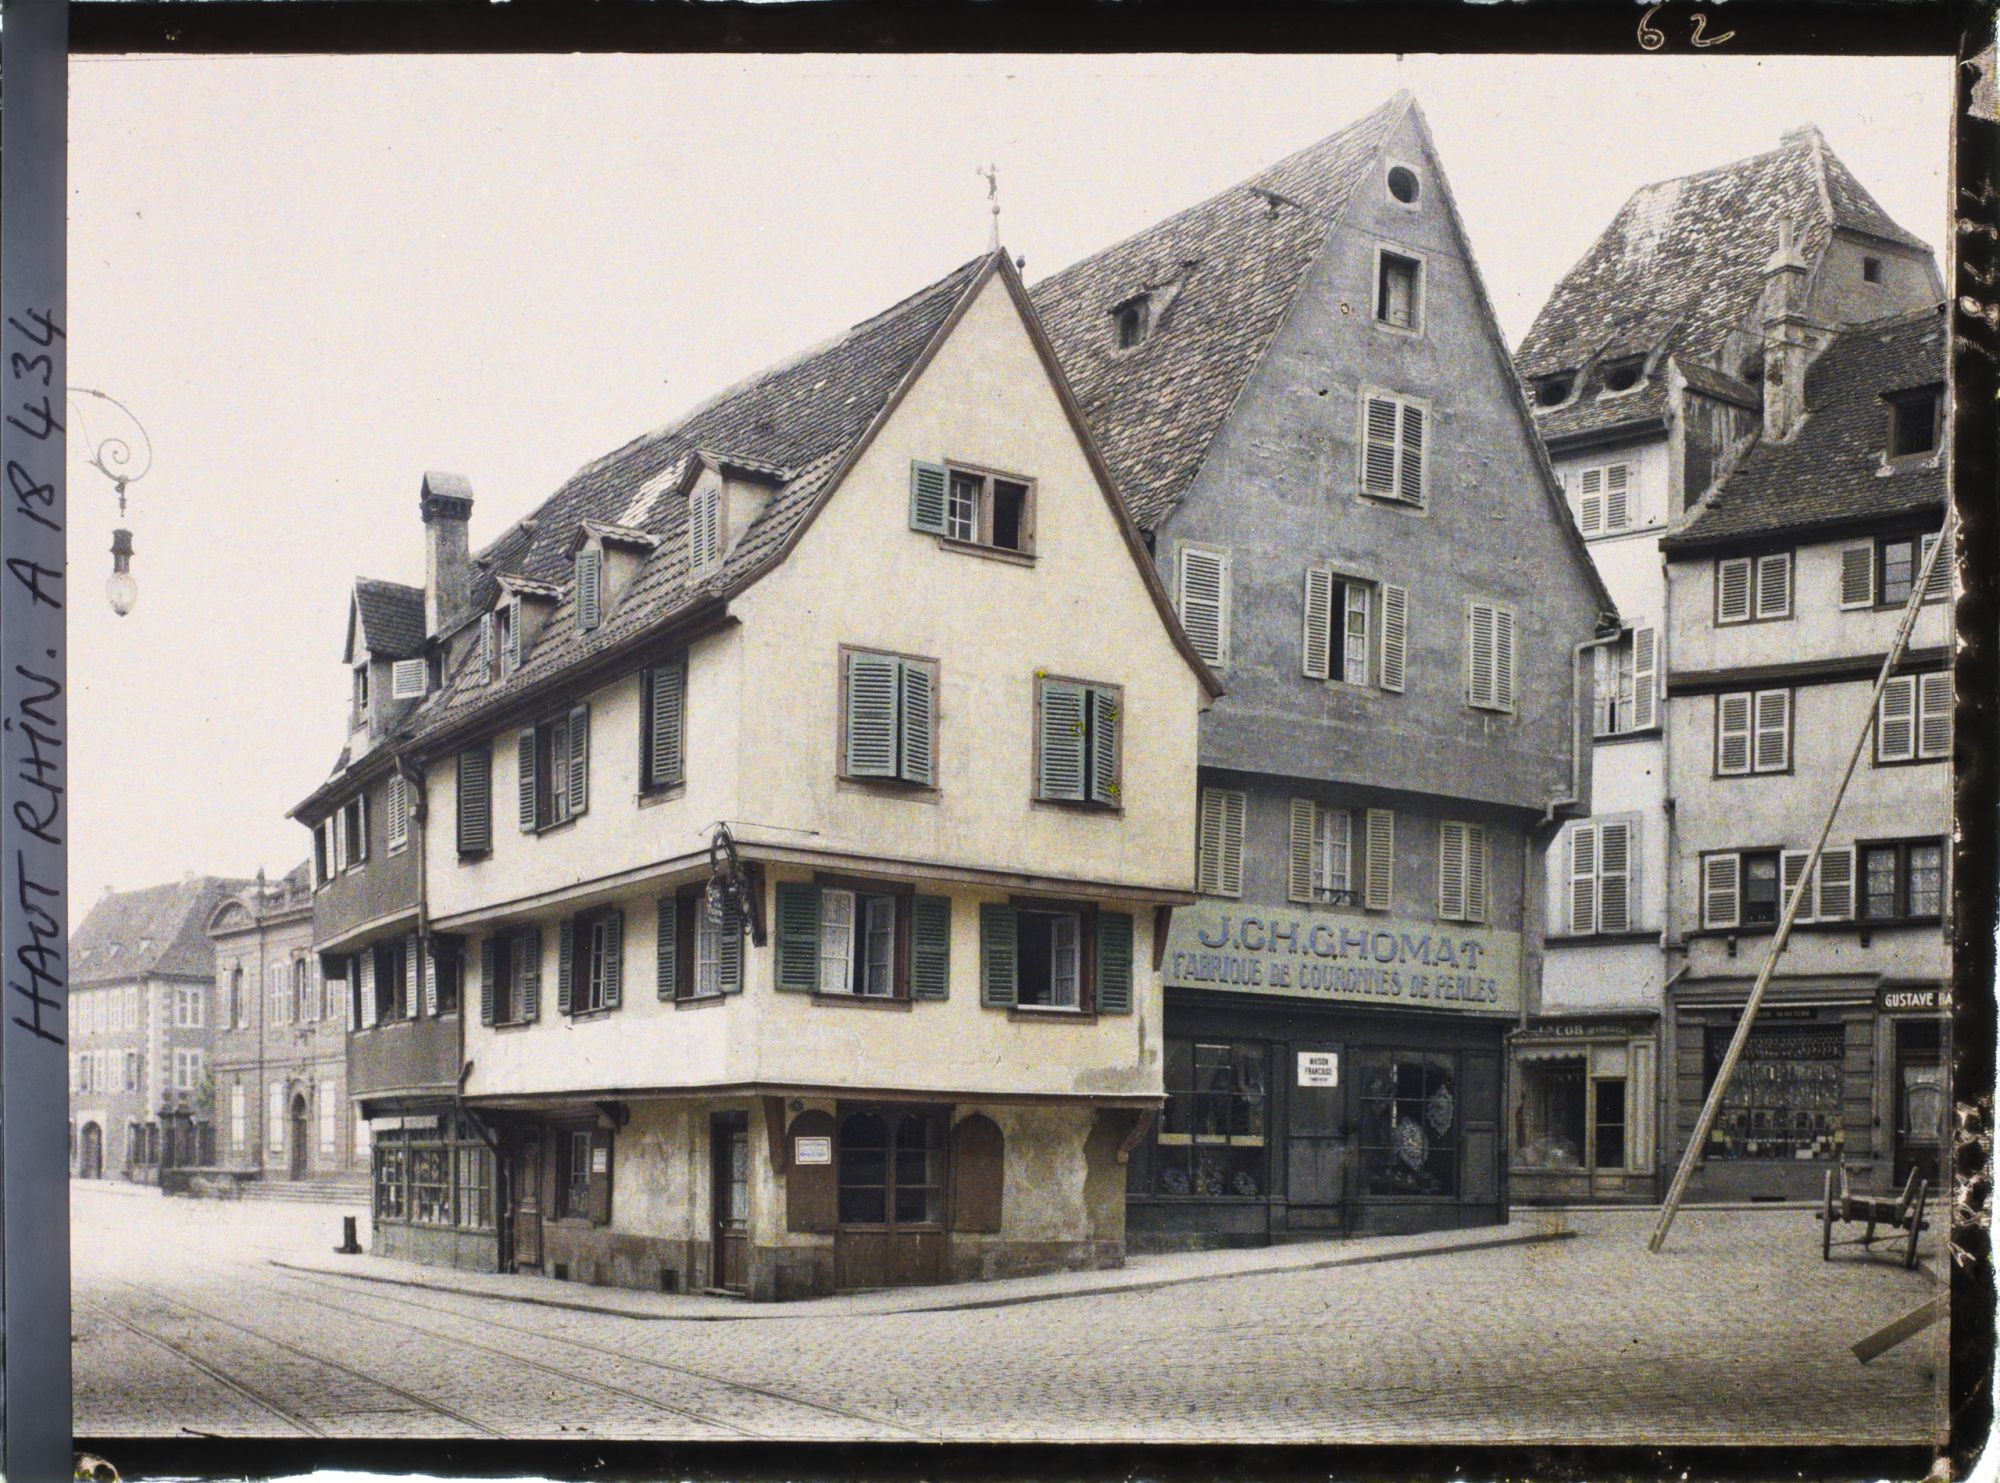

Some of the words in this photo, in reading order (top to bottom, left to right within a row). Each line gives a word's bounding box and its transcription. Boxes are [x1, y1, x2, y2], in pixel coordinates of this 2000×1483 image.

[7, 557, 62, 609] A
[13, 849, 65, 1046] HAUT
[1171, 950, 1262, 987] FABRIQUE
[1268, 961, 1291, 988] DE
[1298, 960, 1402, 996] COURONNES
[1410, 974, 1430, 998] DE
[1435, 974, 1498, 1004] PERLES
[1884, 992, 1934, 1008] GUSTAVE
